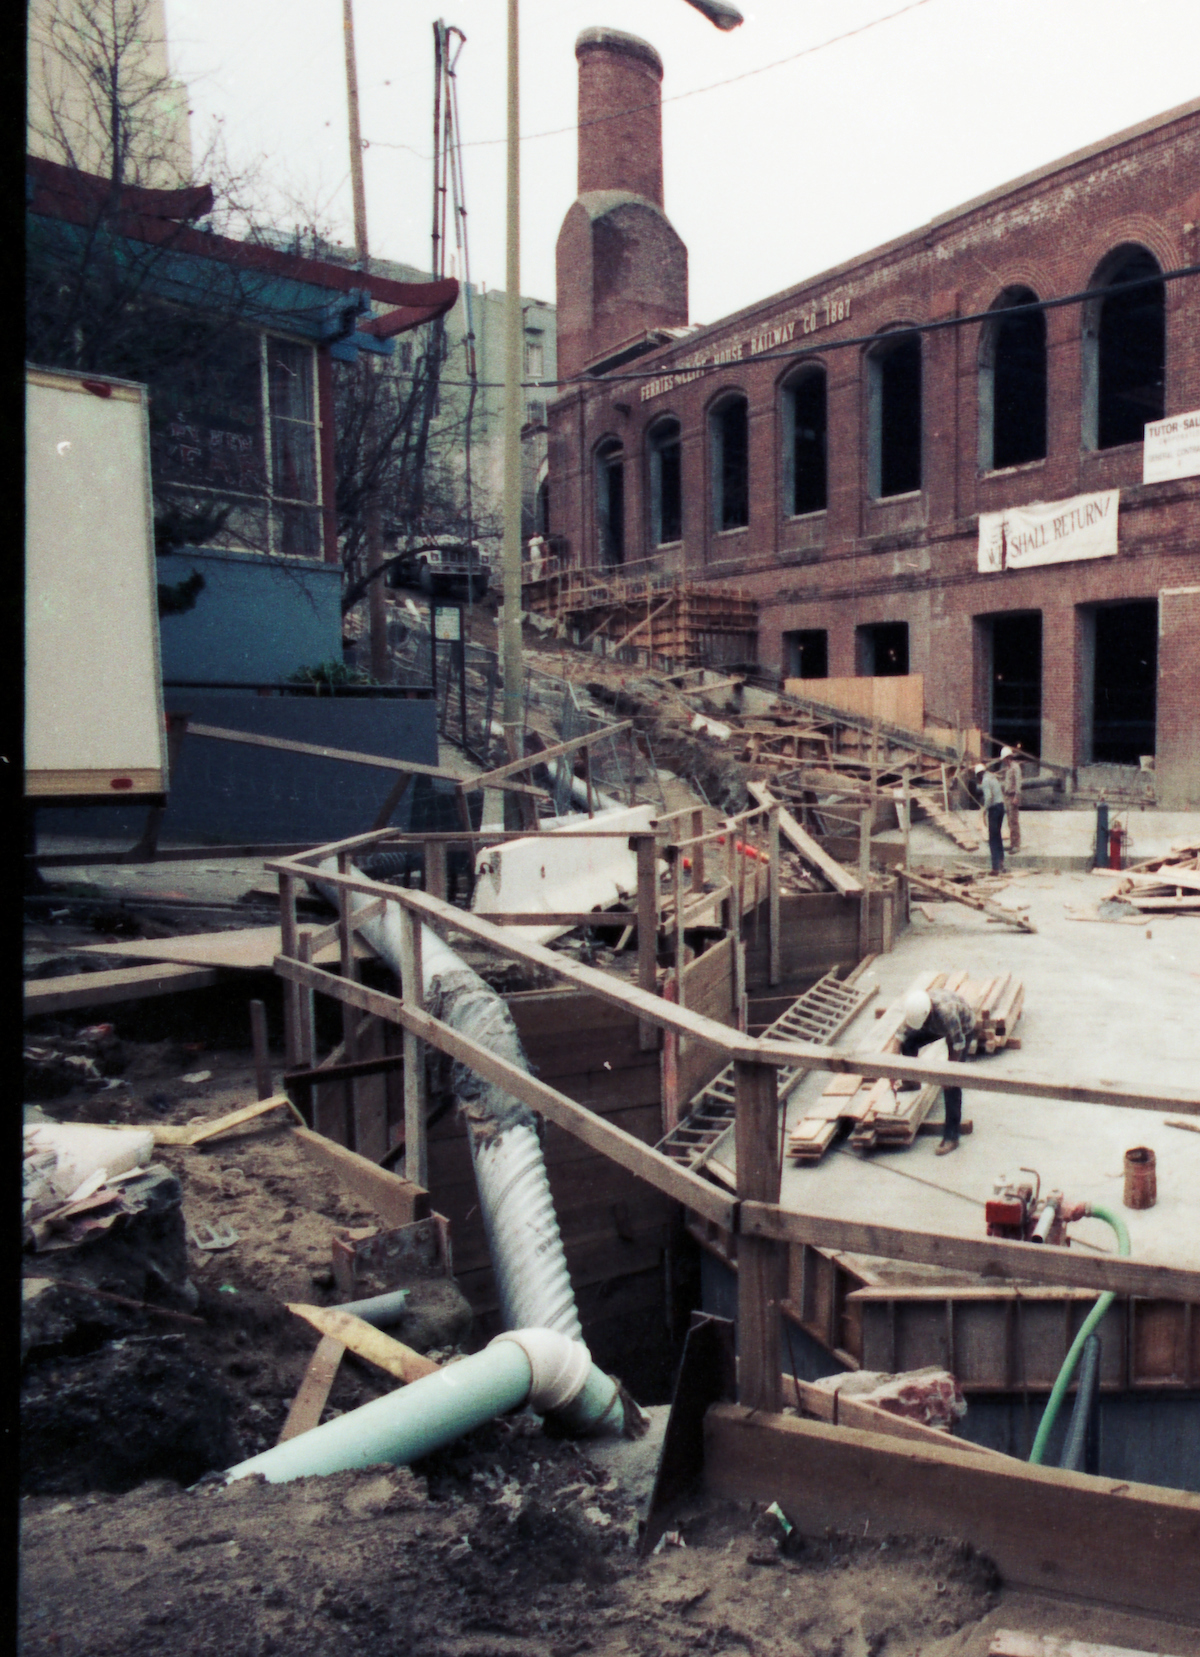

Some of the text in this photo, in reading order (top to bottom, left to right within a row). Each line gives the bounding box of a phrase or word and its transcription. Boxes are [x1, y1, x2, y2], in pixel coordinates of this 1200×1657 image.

[641, 374, 674, 402] FERRIES
[752, 321, 795, 355] RAILWAY
[824, 299, 851, 326] 1887
[1011, 524, 1048, 558] SHALL
